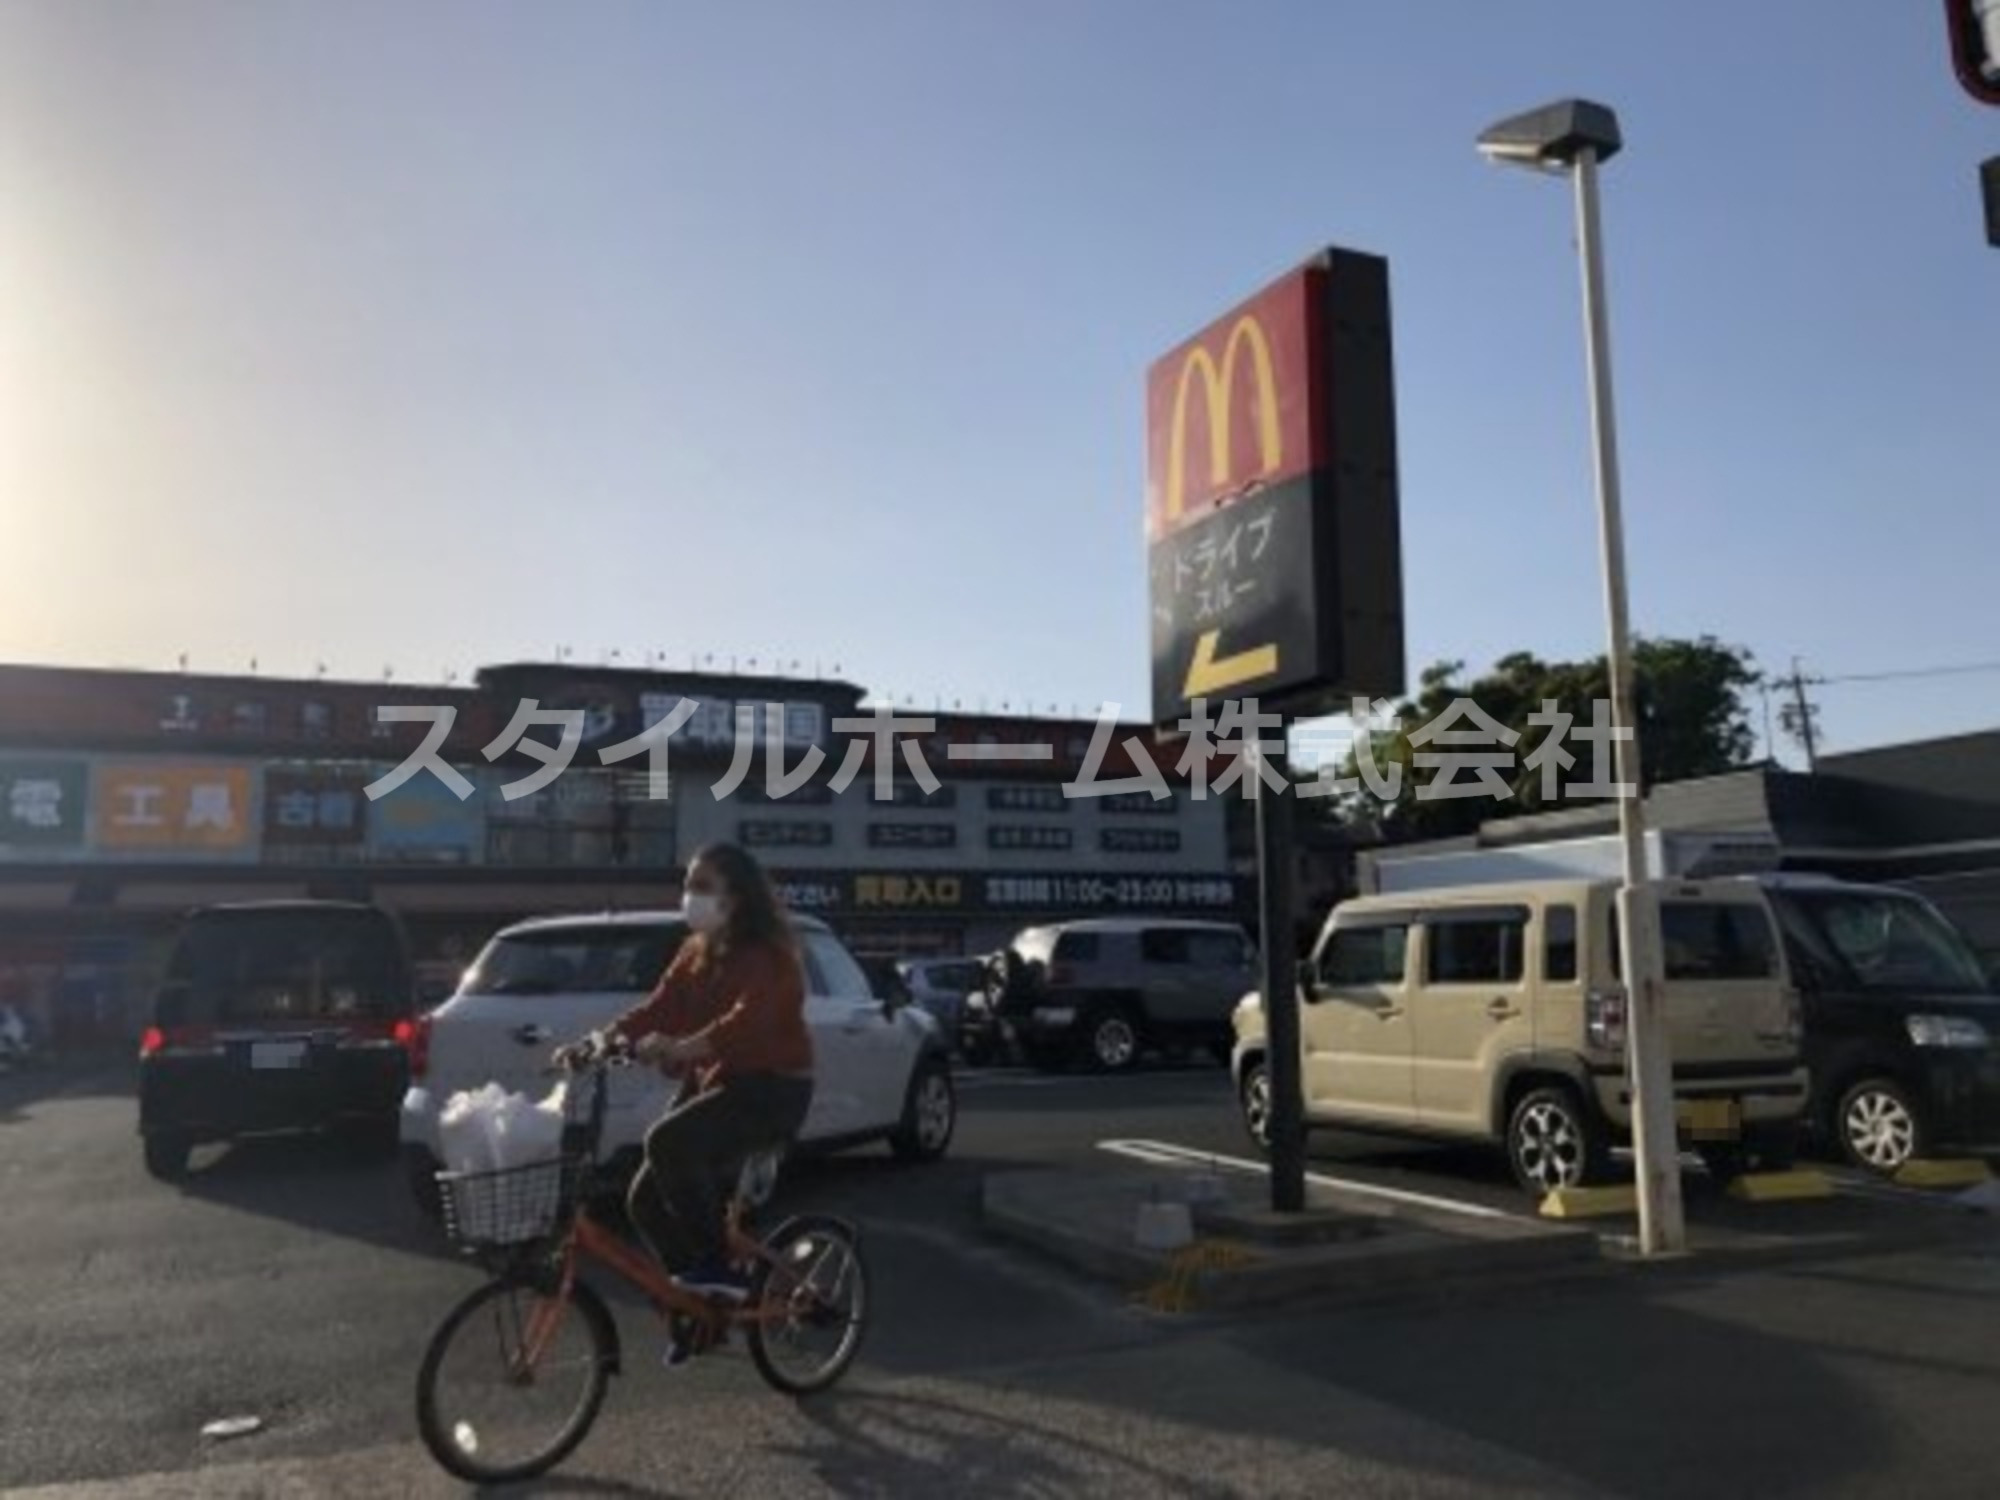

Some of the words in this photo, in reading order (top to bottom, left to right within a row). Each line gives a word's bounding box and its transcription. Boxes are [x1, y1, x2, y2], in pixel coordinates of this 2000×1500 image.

[1166, 313, 1282, 521] M
[1174, 506, 1277, 594] ドライブ
[1194, 578, 1258, 621] スルー
[112, 783, 235, 830] 工具
